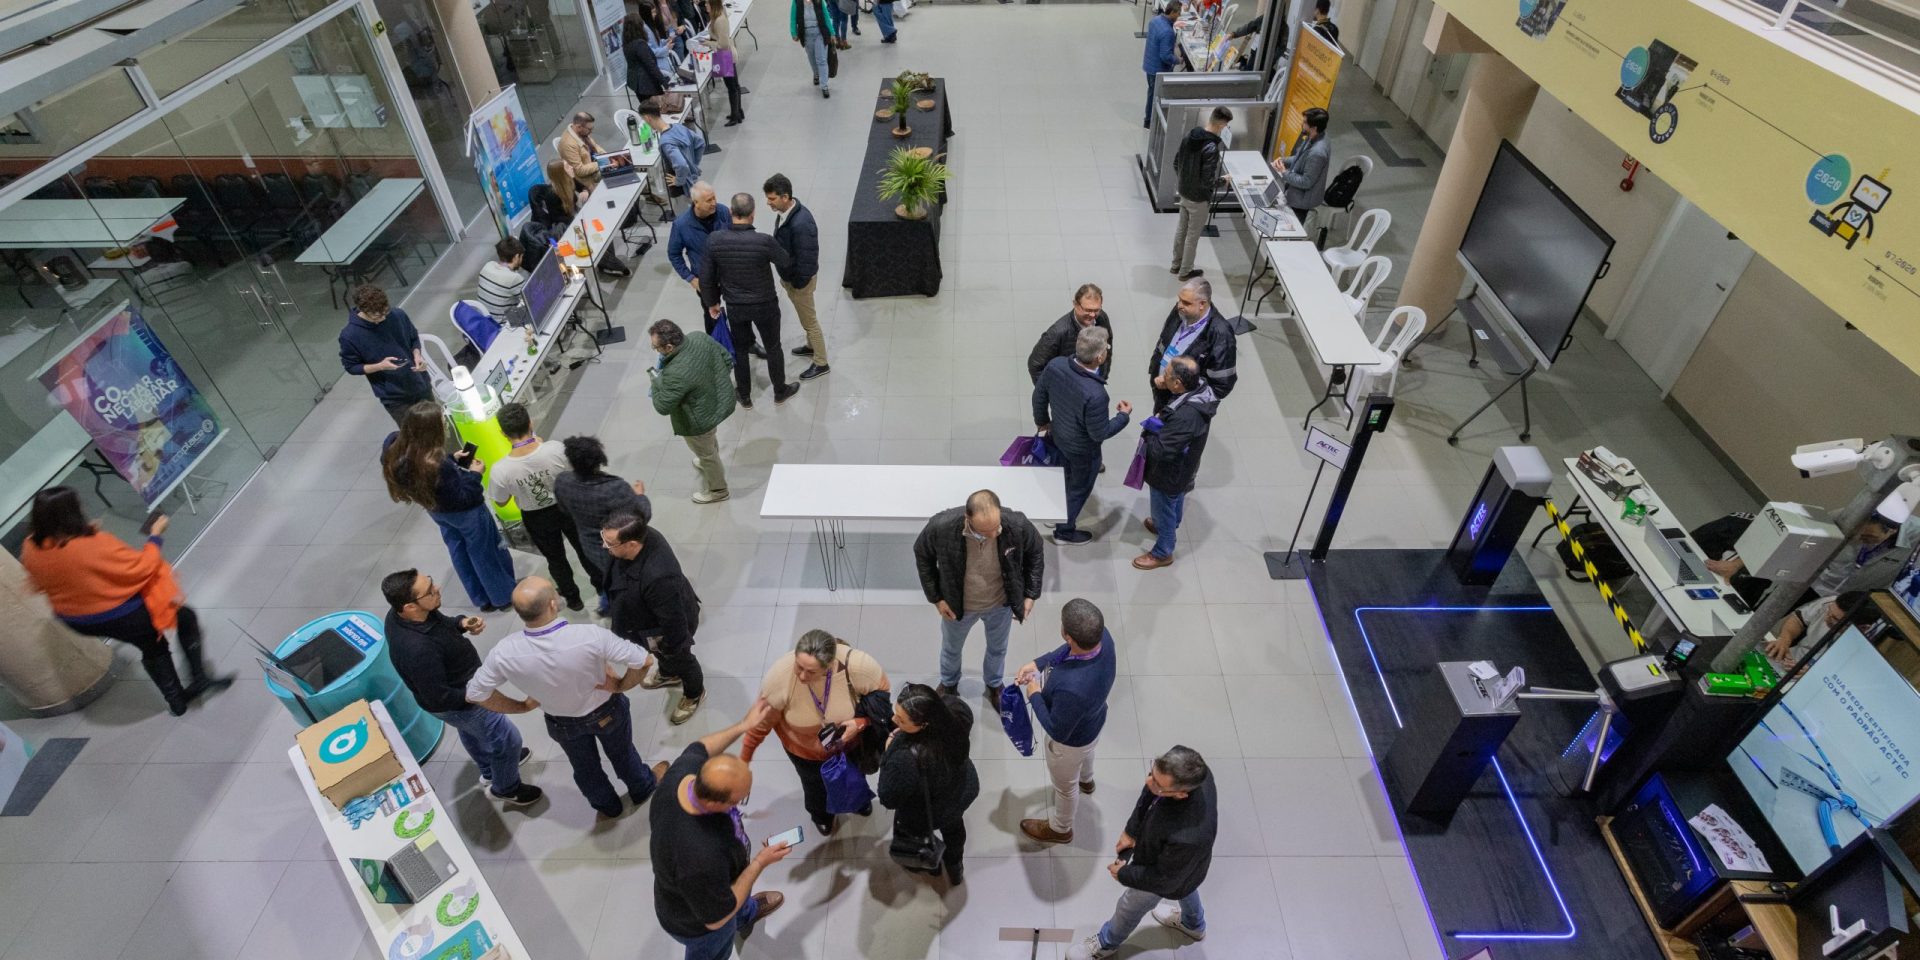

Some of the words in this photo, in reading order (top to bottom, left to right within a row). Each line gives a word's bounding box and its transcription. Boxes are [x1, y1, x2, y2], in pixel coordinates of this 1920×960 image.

[1814, 169, 1842, 191] 2020
[103, 375, 153, 424] NECTAR
[142, 379, 178, 413] CRIAR
[1765, 508, 1785, 533] ACTEC
[1823, 676, 1840, 696] COM
[1846, 705, 1880, 744] PADRÃO
[1880, 746, 1909, 779] ACTEC
[1832, 674, 1846, 690] SUA
[1846, 690, 1865, 711] REDE
[1864, 712, 1910, 767] CERTIFICADA
